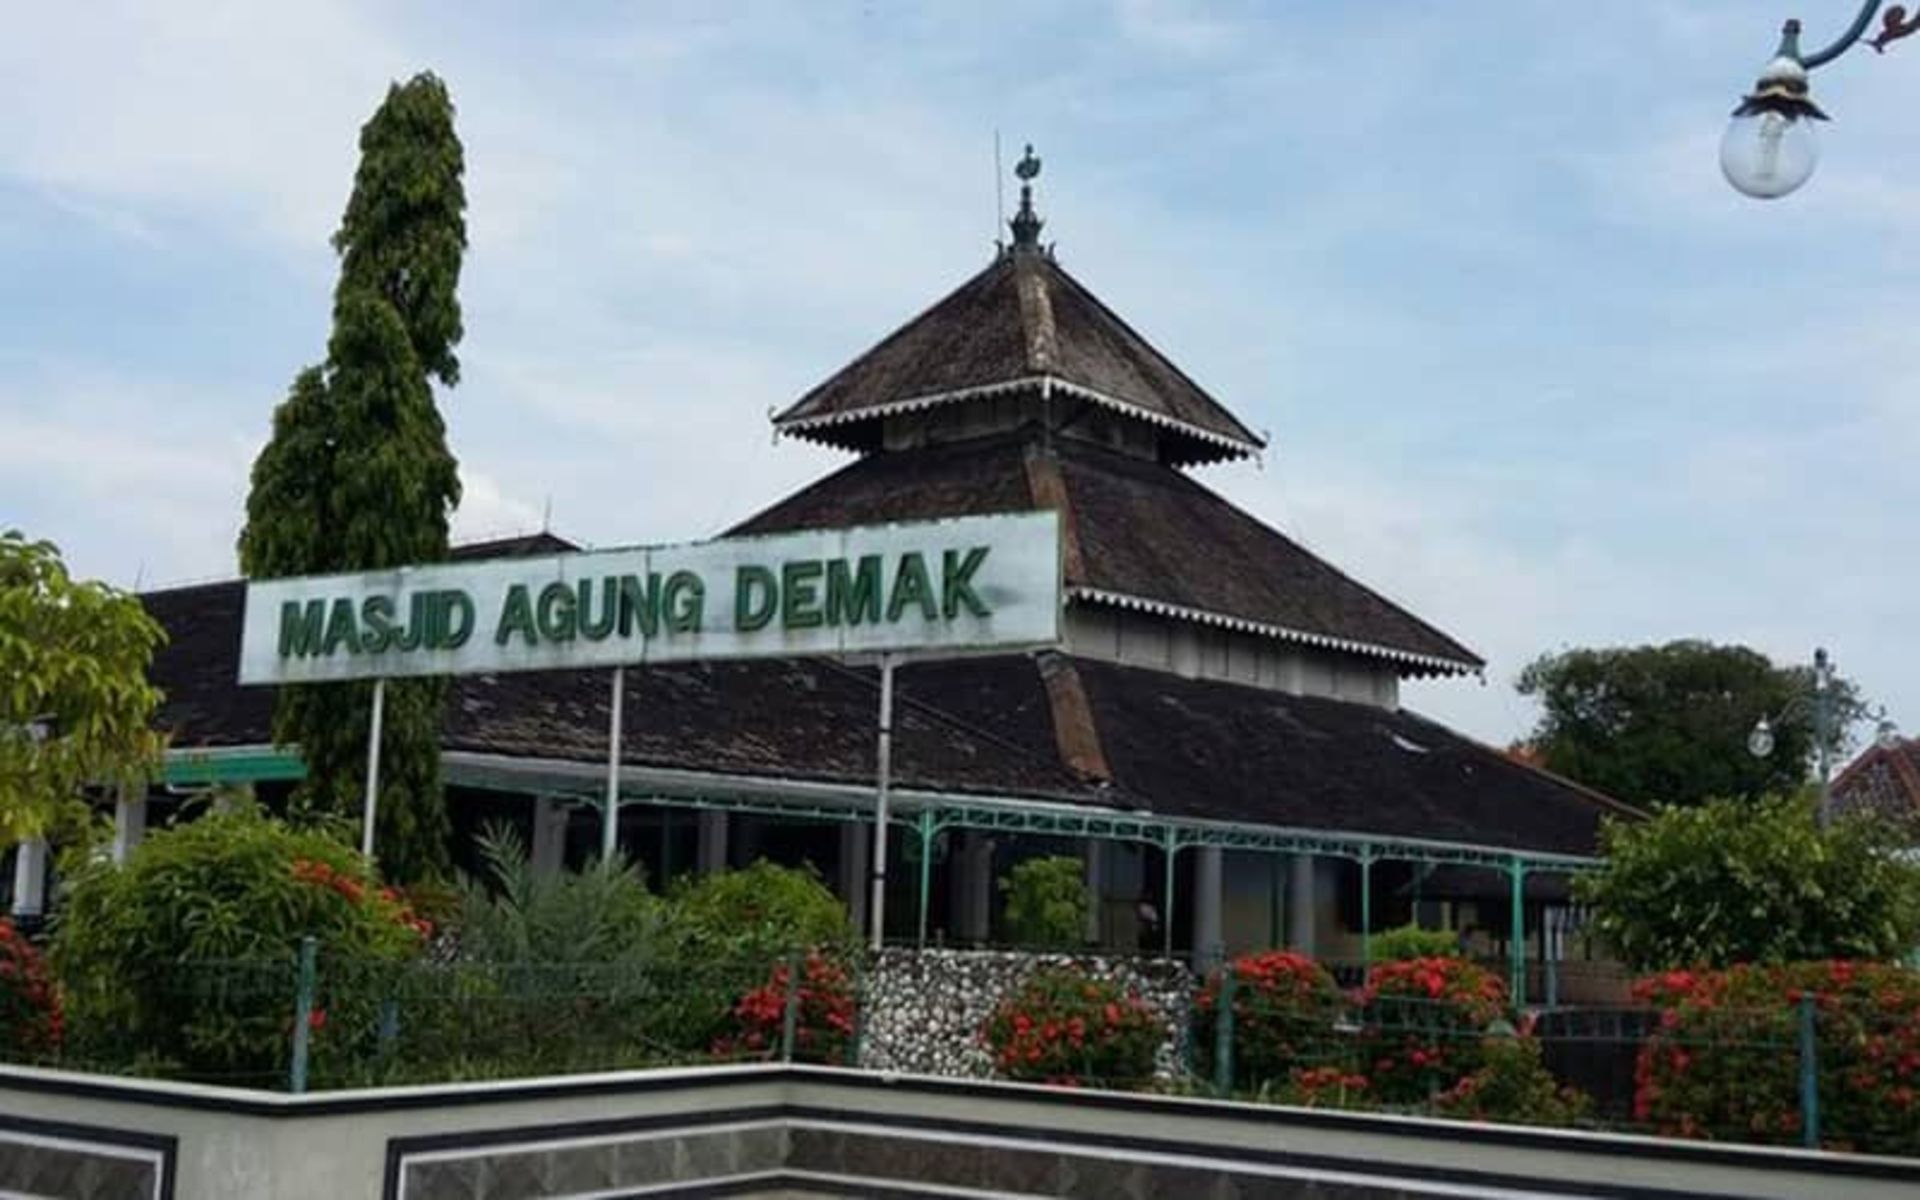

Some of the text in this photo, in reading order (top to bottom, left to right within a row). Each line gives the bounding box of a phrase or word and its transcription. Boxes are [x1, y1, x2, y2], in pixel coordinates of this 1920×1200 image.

[279, 547, 992, 658] MASJID AGUNG DEMAK
